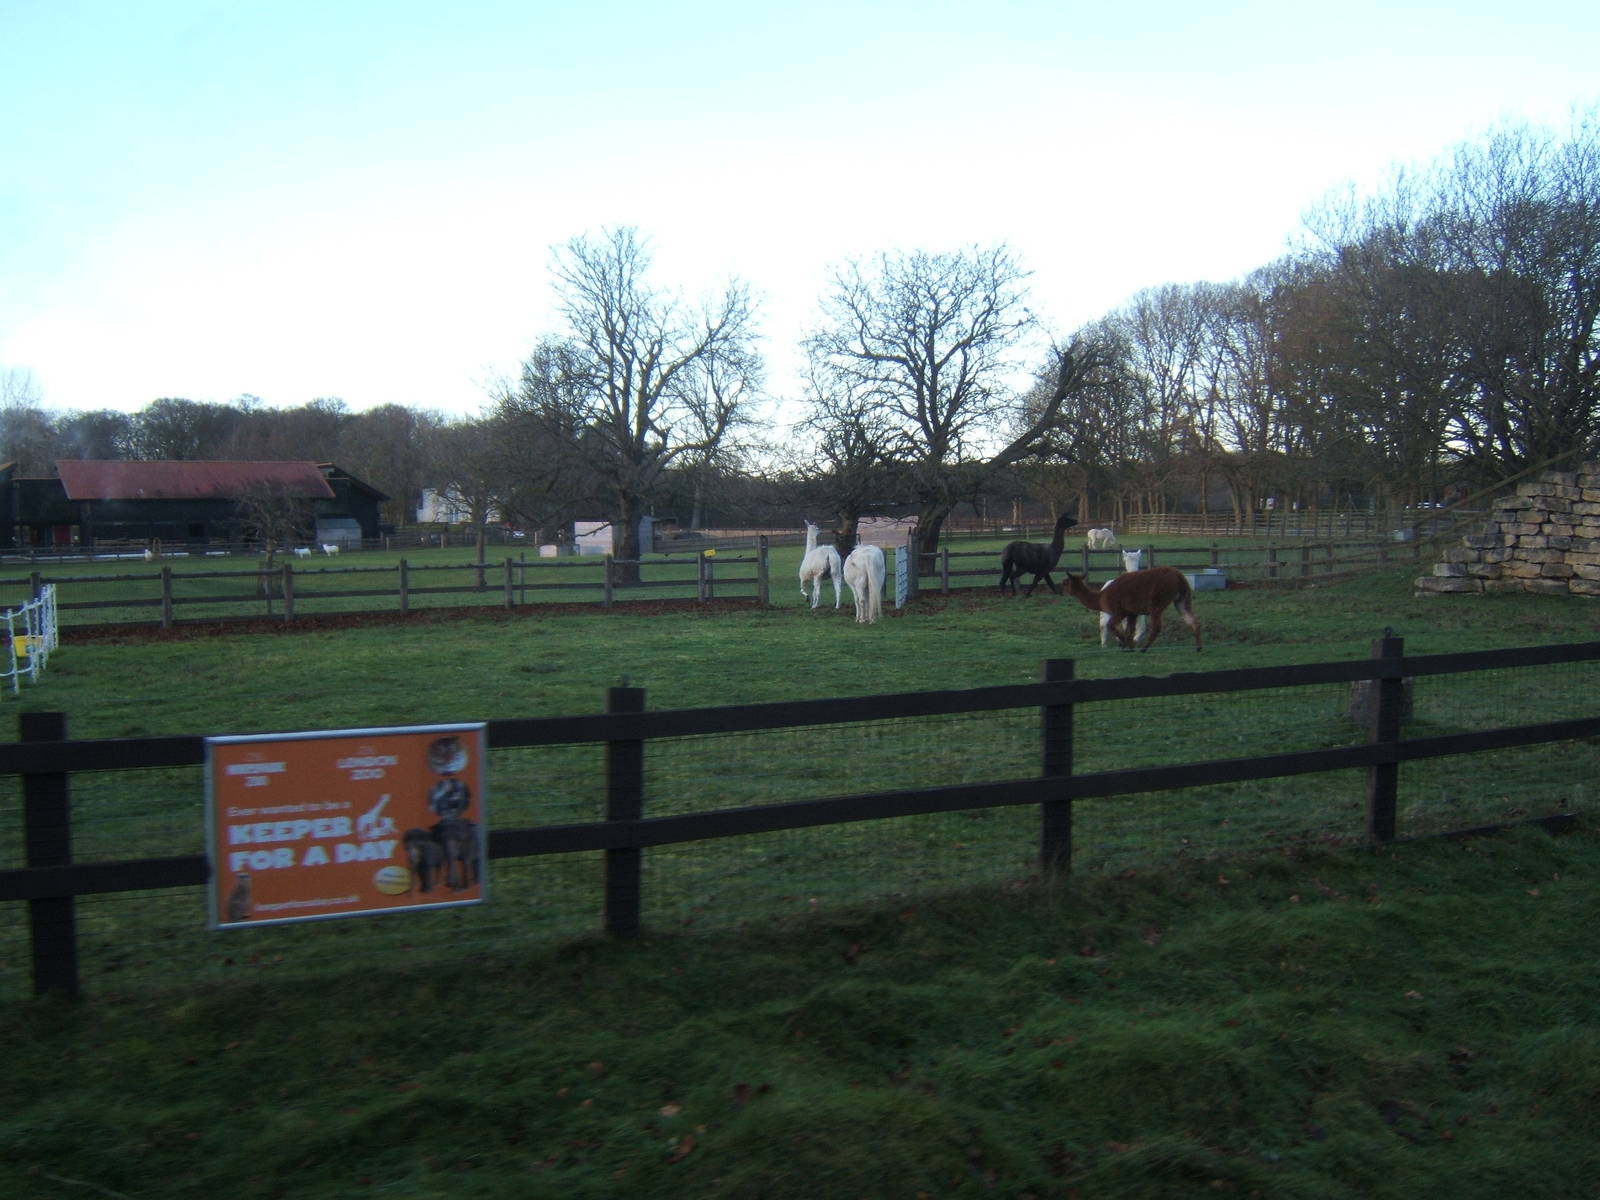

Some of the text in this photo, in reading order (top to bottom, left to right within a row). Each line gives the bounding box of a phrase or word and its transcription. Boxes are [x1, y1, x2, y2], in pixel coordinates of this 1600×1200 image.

[228, 816, 352, 845] KEEPER
[230, 839, 398, 872] FOR A DAY
